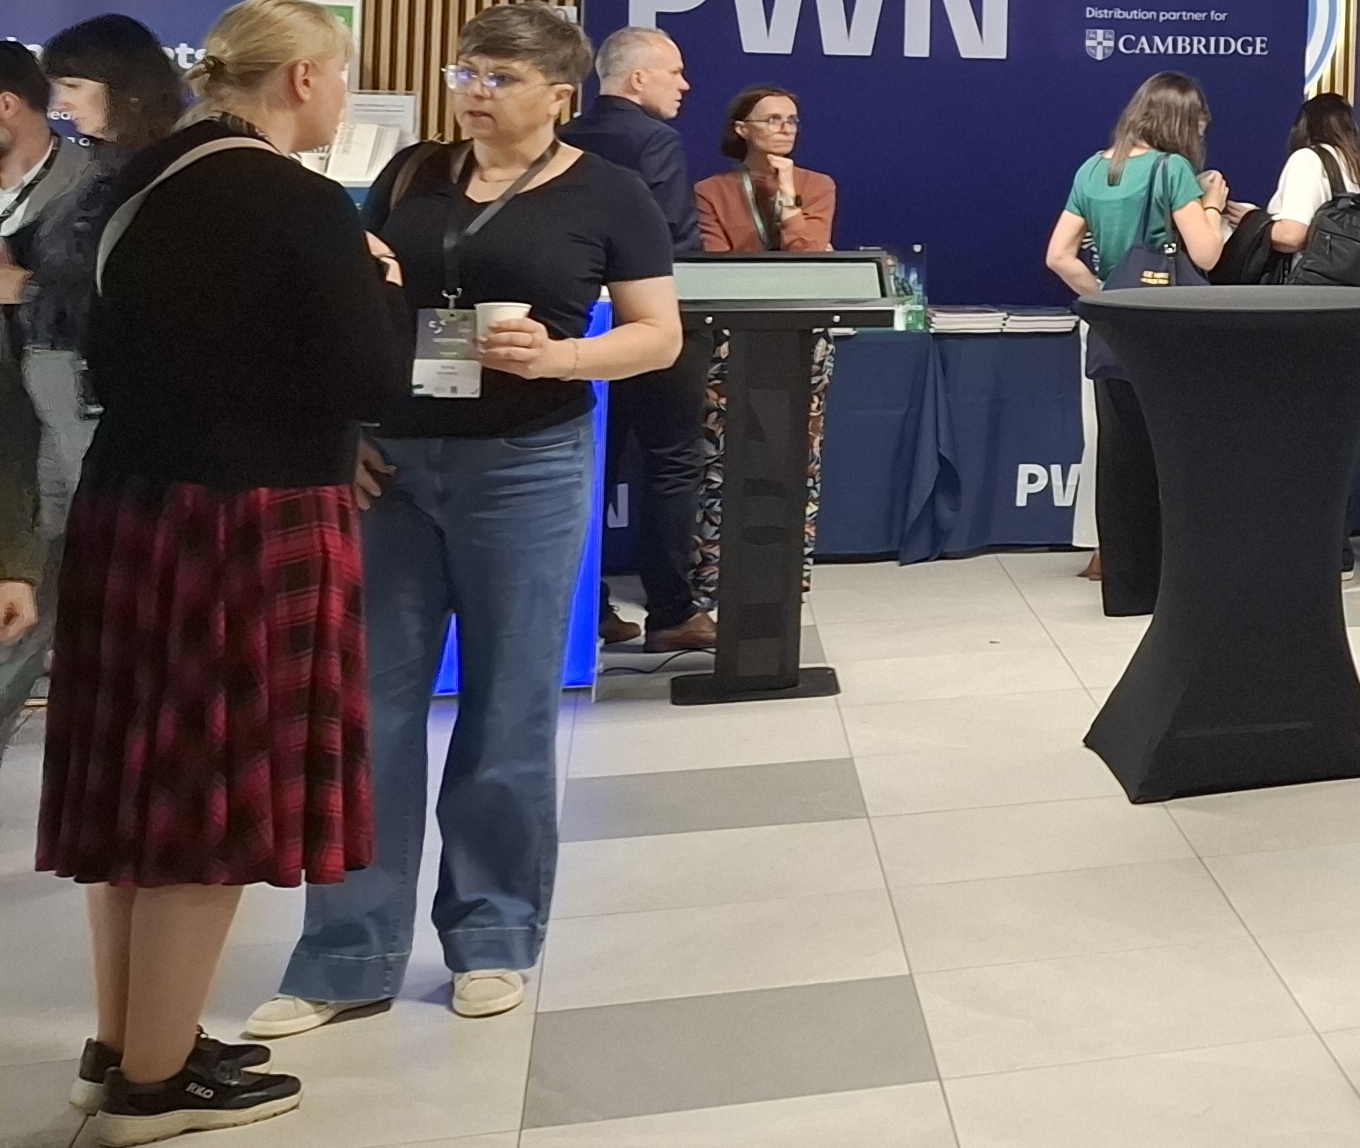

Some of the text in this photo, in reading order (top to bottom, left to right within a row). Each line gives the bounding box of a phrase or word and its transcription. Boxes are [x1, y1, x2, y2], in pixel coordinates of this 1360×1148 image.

[1085, 6, 1228, 23] Distribution partner for
[1118, 34, 1269, 56] CAMBRIDGE
